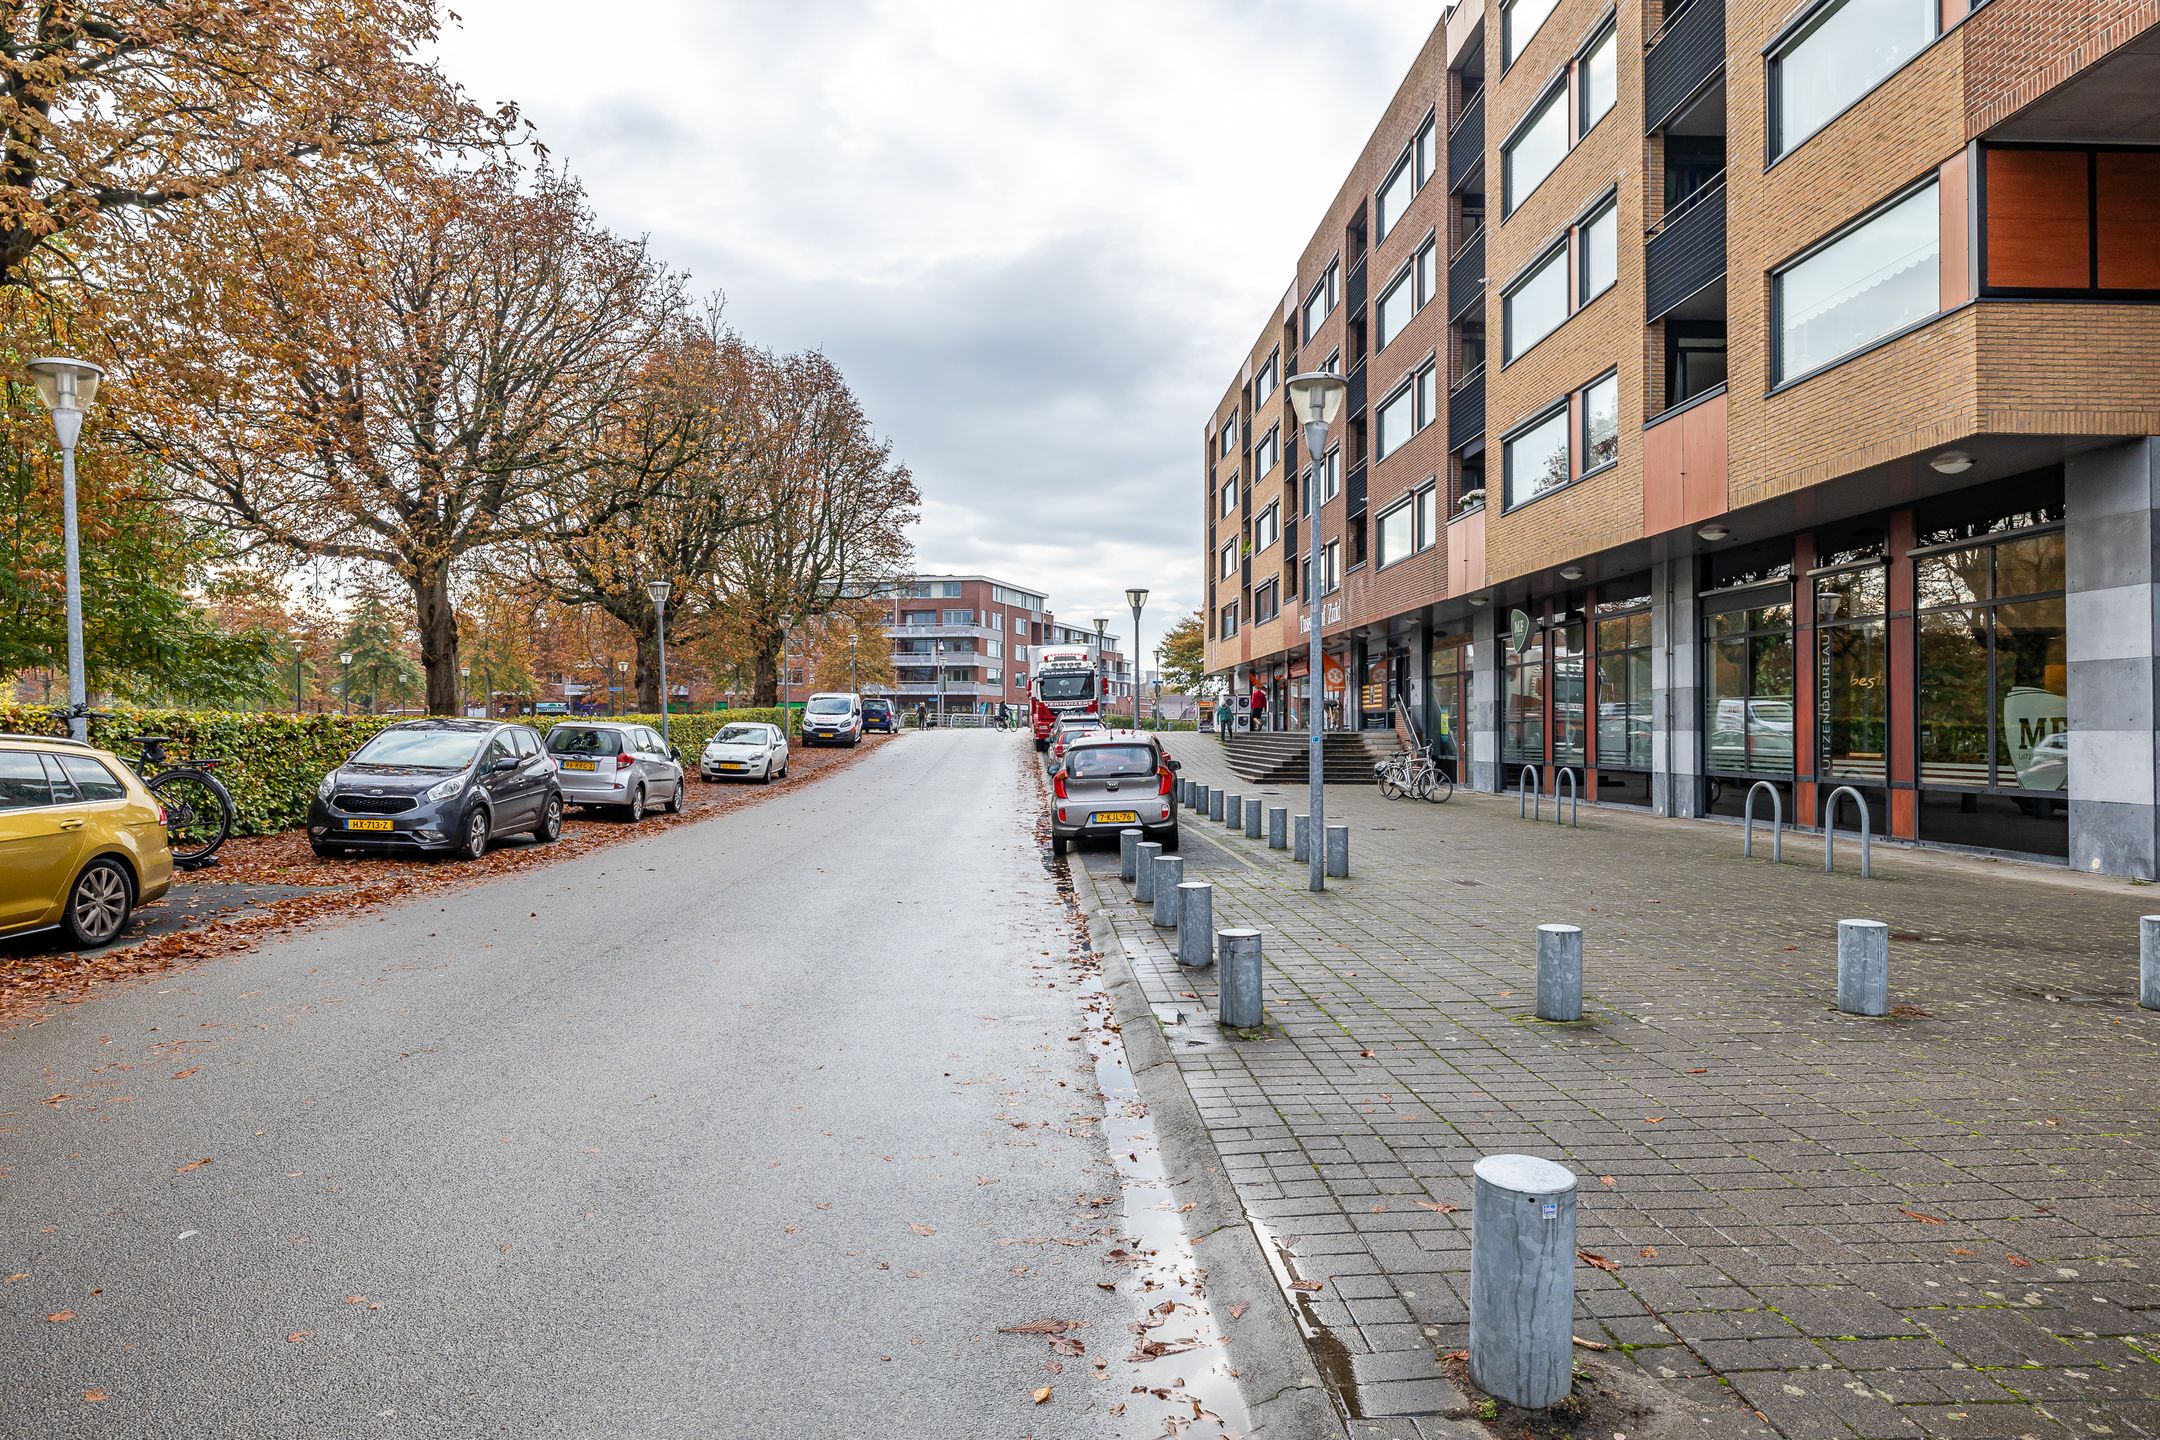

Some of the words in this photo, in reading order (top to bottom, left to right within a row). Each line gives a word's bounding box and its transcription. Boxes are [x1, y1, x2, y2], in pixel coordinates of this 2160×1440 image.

[1822, 634, 1831, 770] UITZENDBUREAU
[1100, 813, 1132, 821] 7-KJL-76
[352, 821, 388, 830] HX-713-Z
